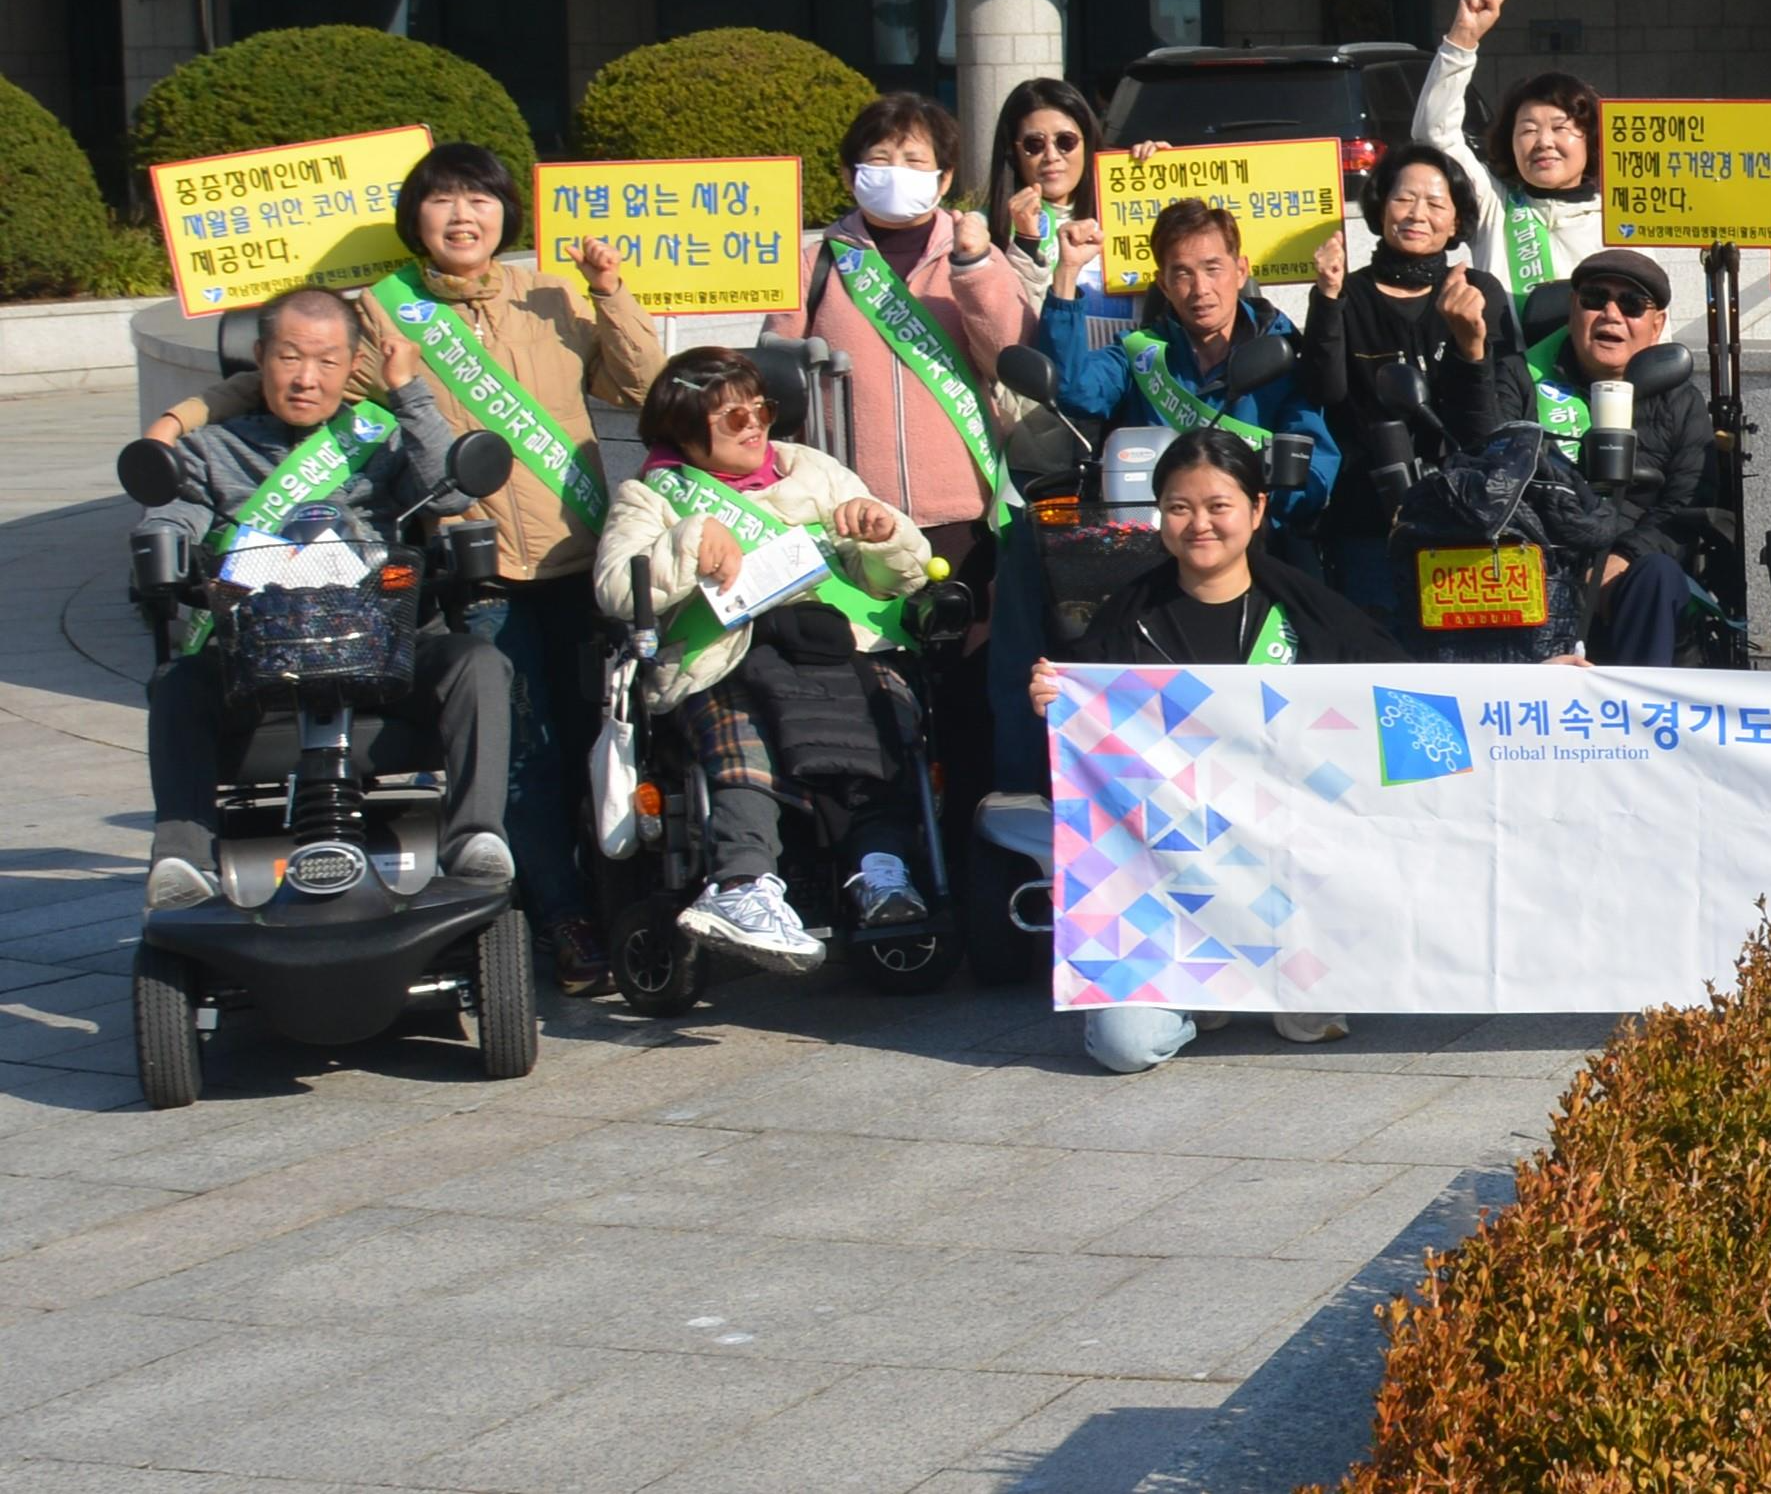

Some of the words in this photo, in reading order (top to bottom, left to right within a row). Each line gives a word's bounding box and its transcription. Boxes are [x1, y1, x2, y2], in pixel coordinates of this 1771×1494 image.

[1611, 115, 1705, 143] 중증장애인
[176, 155, 348, 206] 중증장애인에게
[1109, 158, 1249, 193] 중증장애인에게
[1612, 151, 1661, 180] 가정에
[1667, 152, 1732, 180] 주거환경
[182, 206, 251, 240] 재활을
[258, 198, 304, 229] 위한
[312, 190, 358, 219] 코어
[553, 184, 610, 218] 차별
[622, 183, 679, 218] 없는
[691, 181, 760, 217] 세상,
[1249, 188, 1334, 219] 힐링캠프를
[1612, 186, 1693, 214] 제공한다.
[190, 237, 300, 276] 제공한다.
[555, 234, 642, 267] 더어
[654, 234, 711, 266] 사는
[723, 231, 782, 264] 하남
[1432, 565, 1529, 605] 안전운전
[1480, 700, 1551, 738] 세계
[1558, 699, 1630, 739] 속의
[1489, 744, 1546, 761] Global
[1553, 744, 1650, 764] Inspiration
